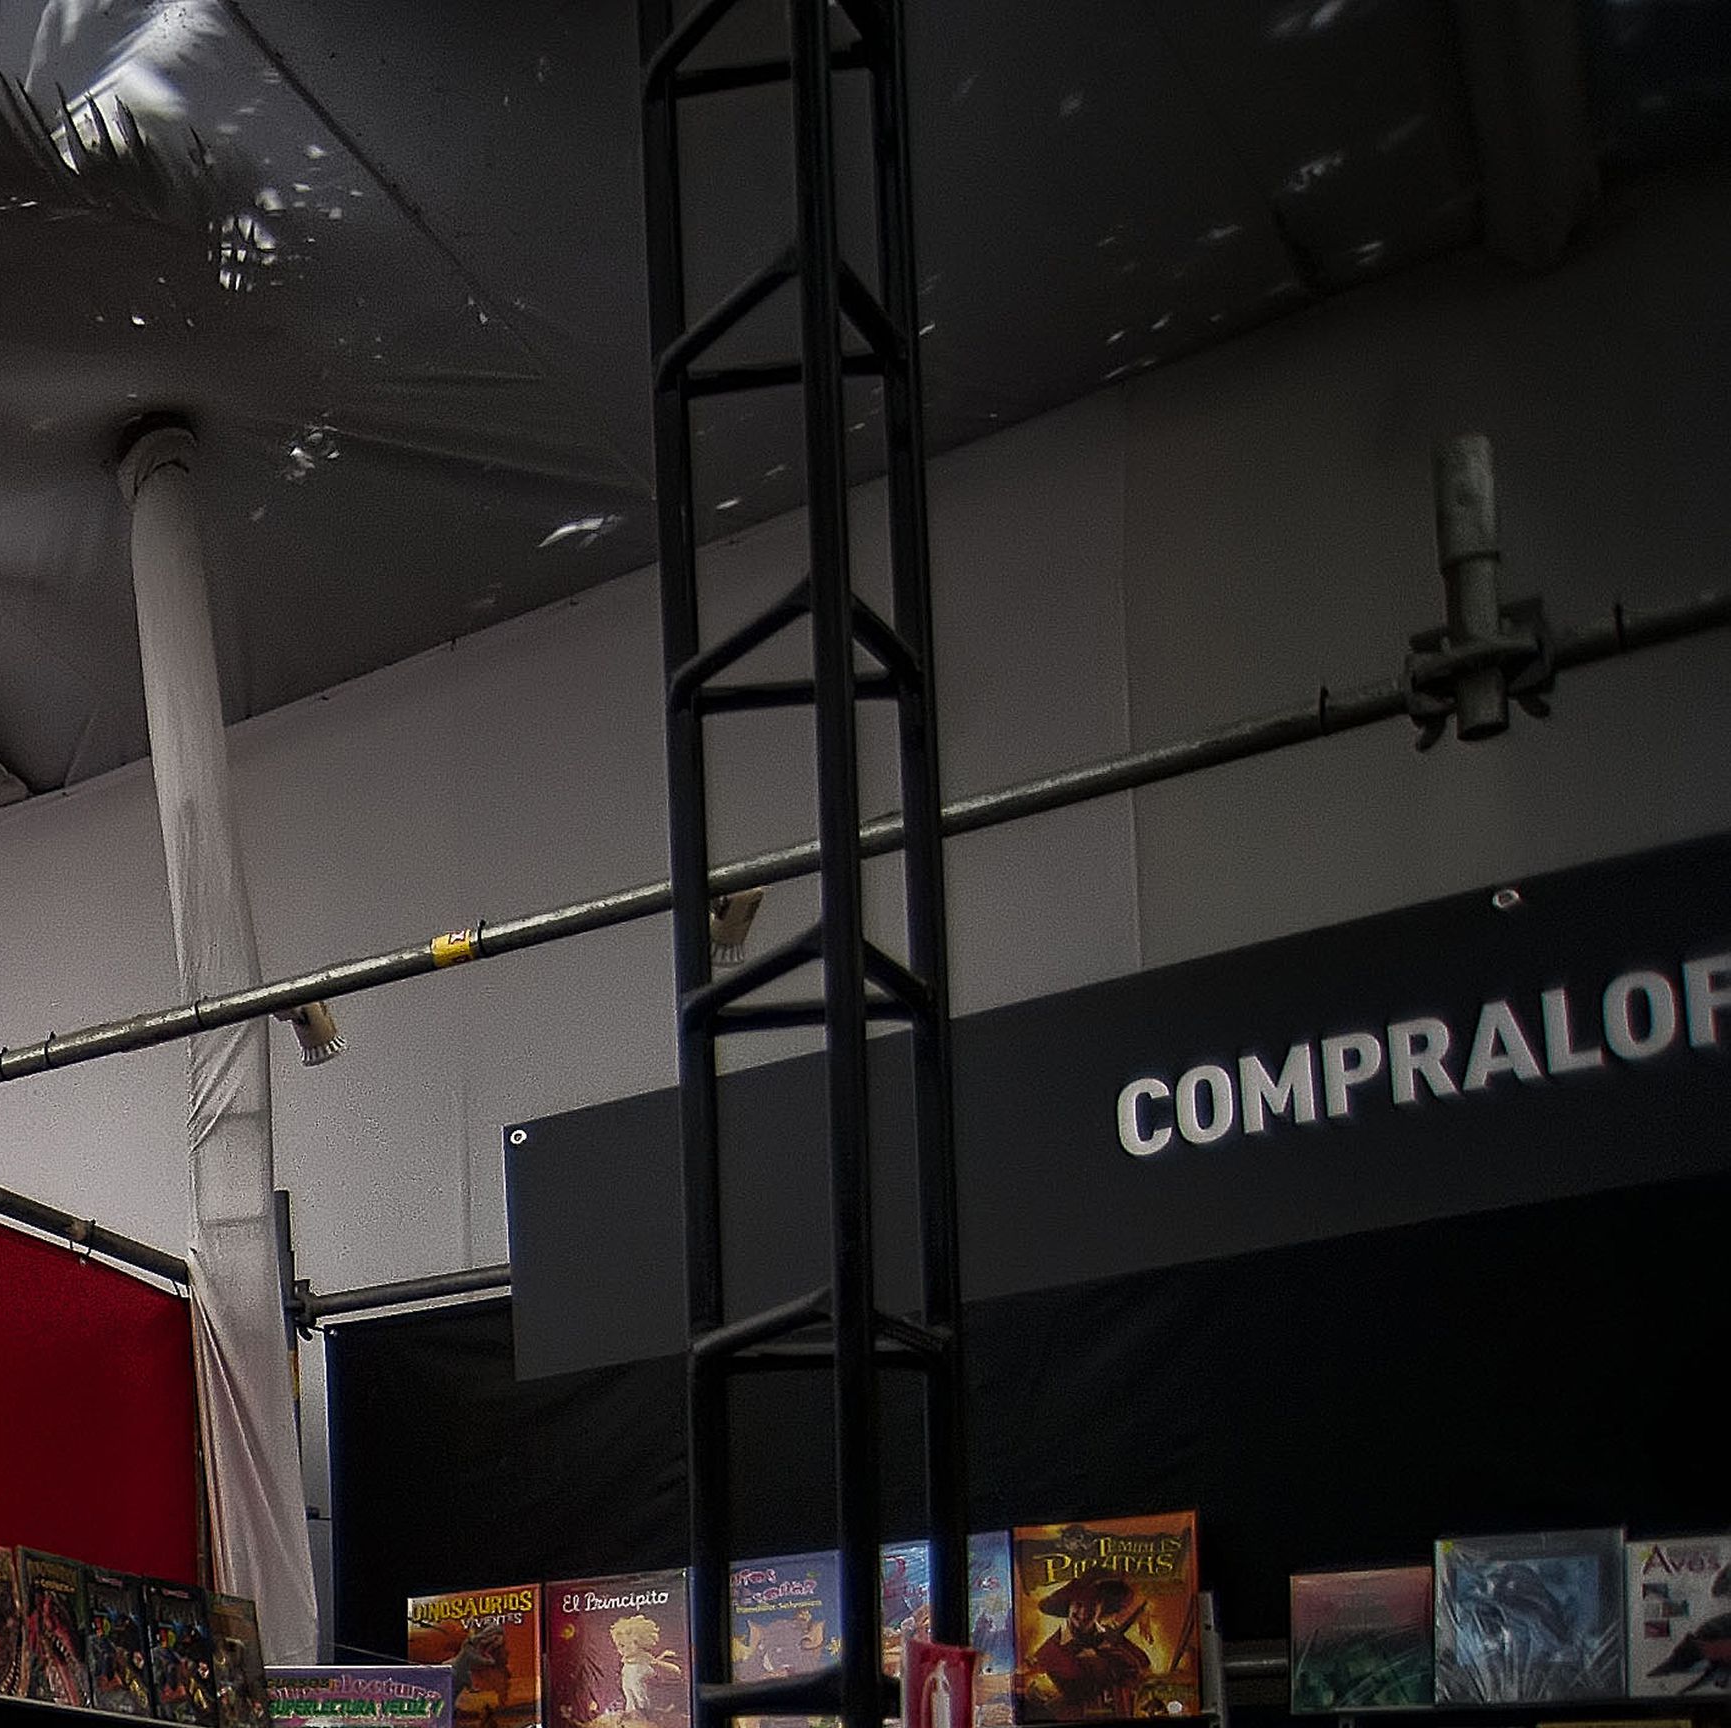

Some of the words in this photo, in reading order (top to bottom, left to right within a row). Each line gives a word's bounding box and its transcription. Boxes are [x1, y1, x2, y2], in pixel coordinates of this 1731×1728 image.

[412, 1591, 533, 1623] DINOSAURIOS
[563, 1594, 581, 1612] El
[584, 1589, 669, 1612] Principito
